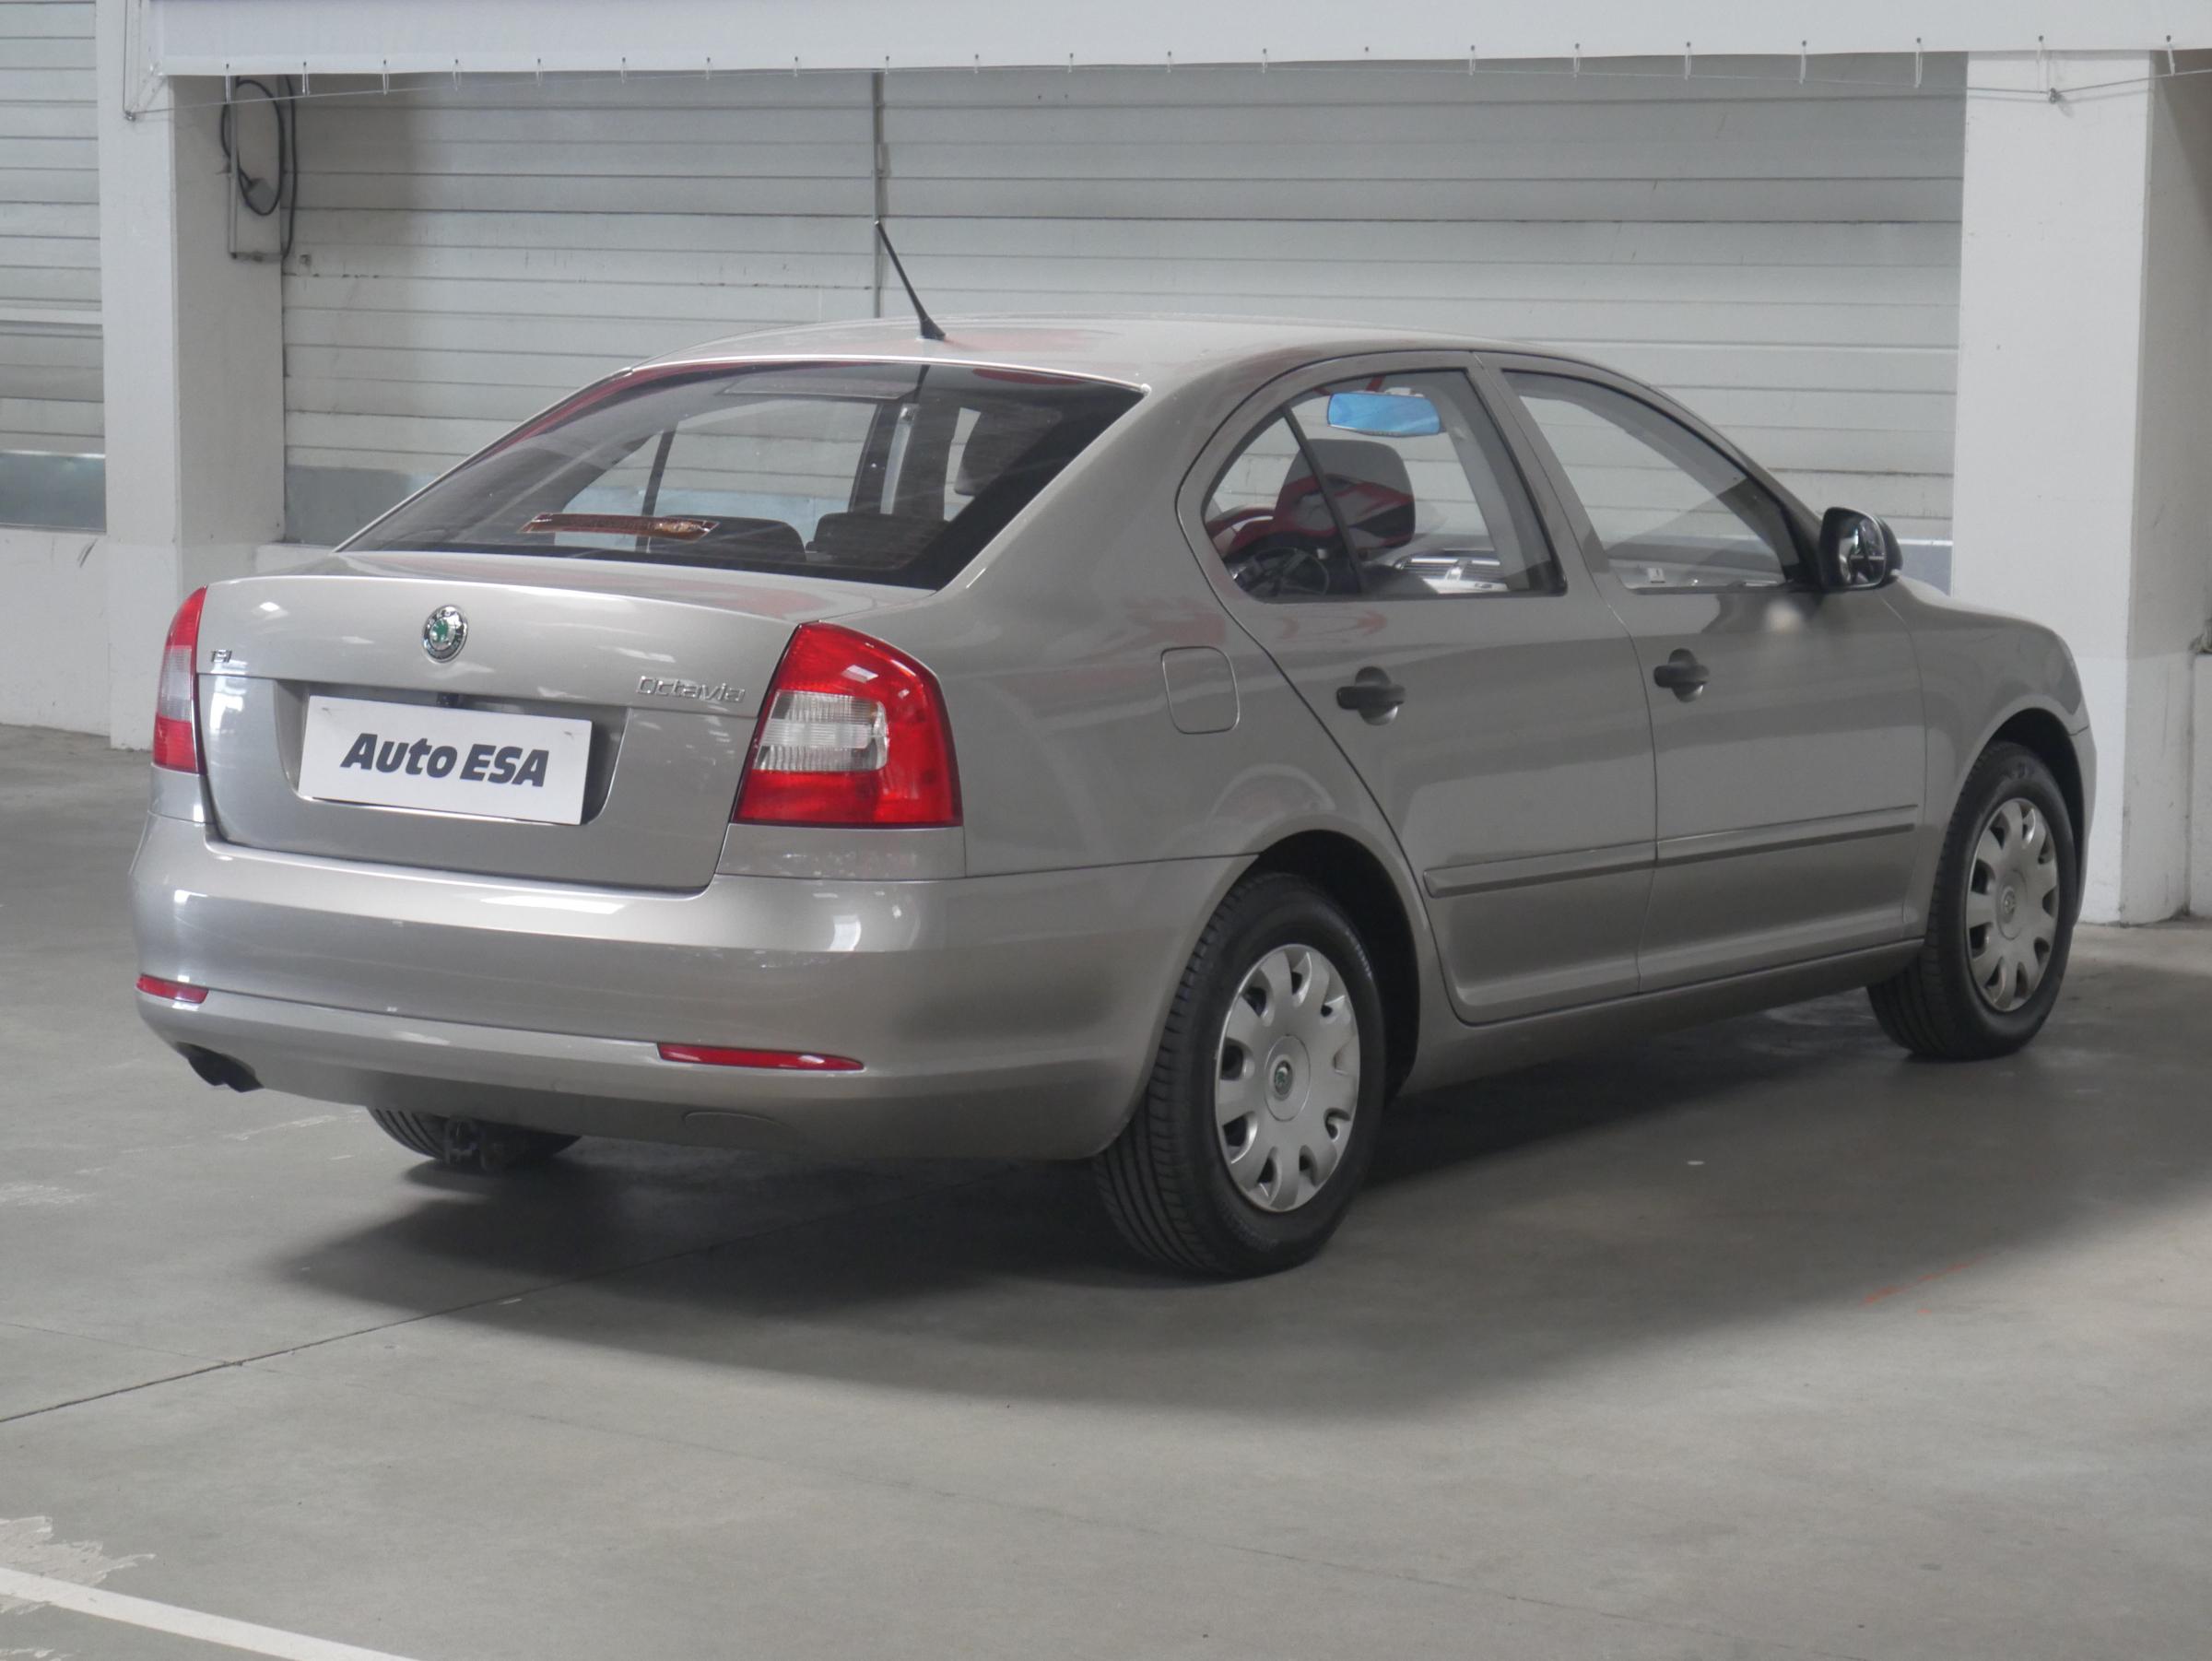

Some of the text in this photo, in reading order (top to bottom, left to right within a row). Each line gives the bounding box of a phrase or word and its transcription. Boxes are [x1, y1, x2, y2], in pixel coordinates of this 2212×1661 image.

[636, 675, 745, 701] Octavia
[340, 733, 549, 787] Auto ESA
